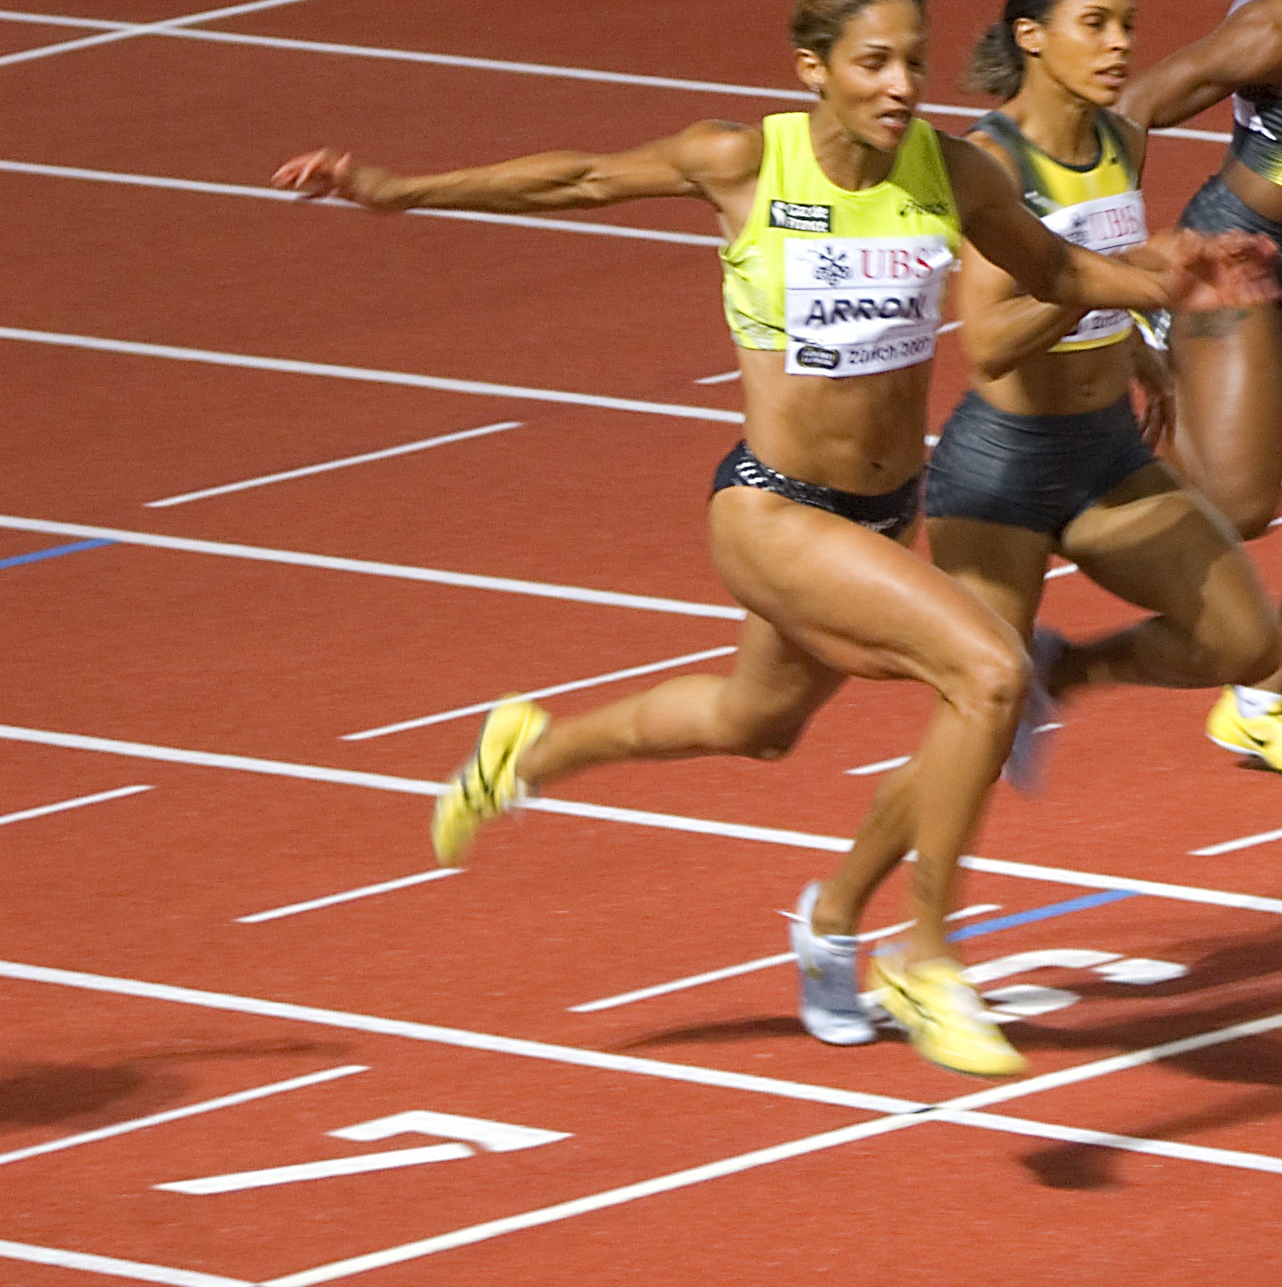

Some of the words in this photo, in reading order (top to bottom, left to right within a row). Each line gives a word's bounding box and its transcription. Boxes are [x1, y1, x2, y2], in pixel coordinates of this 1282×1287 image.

[860, 247, 934, 279] UBS
[805, 294, 928, 325] ARRON
[149, 1110, 576, 1195] 7
